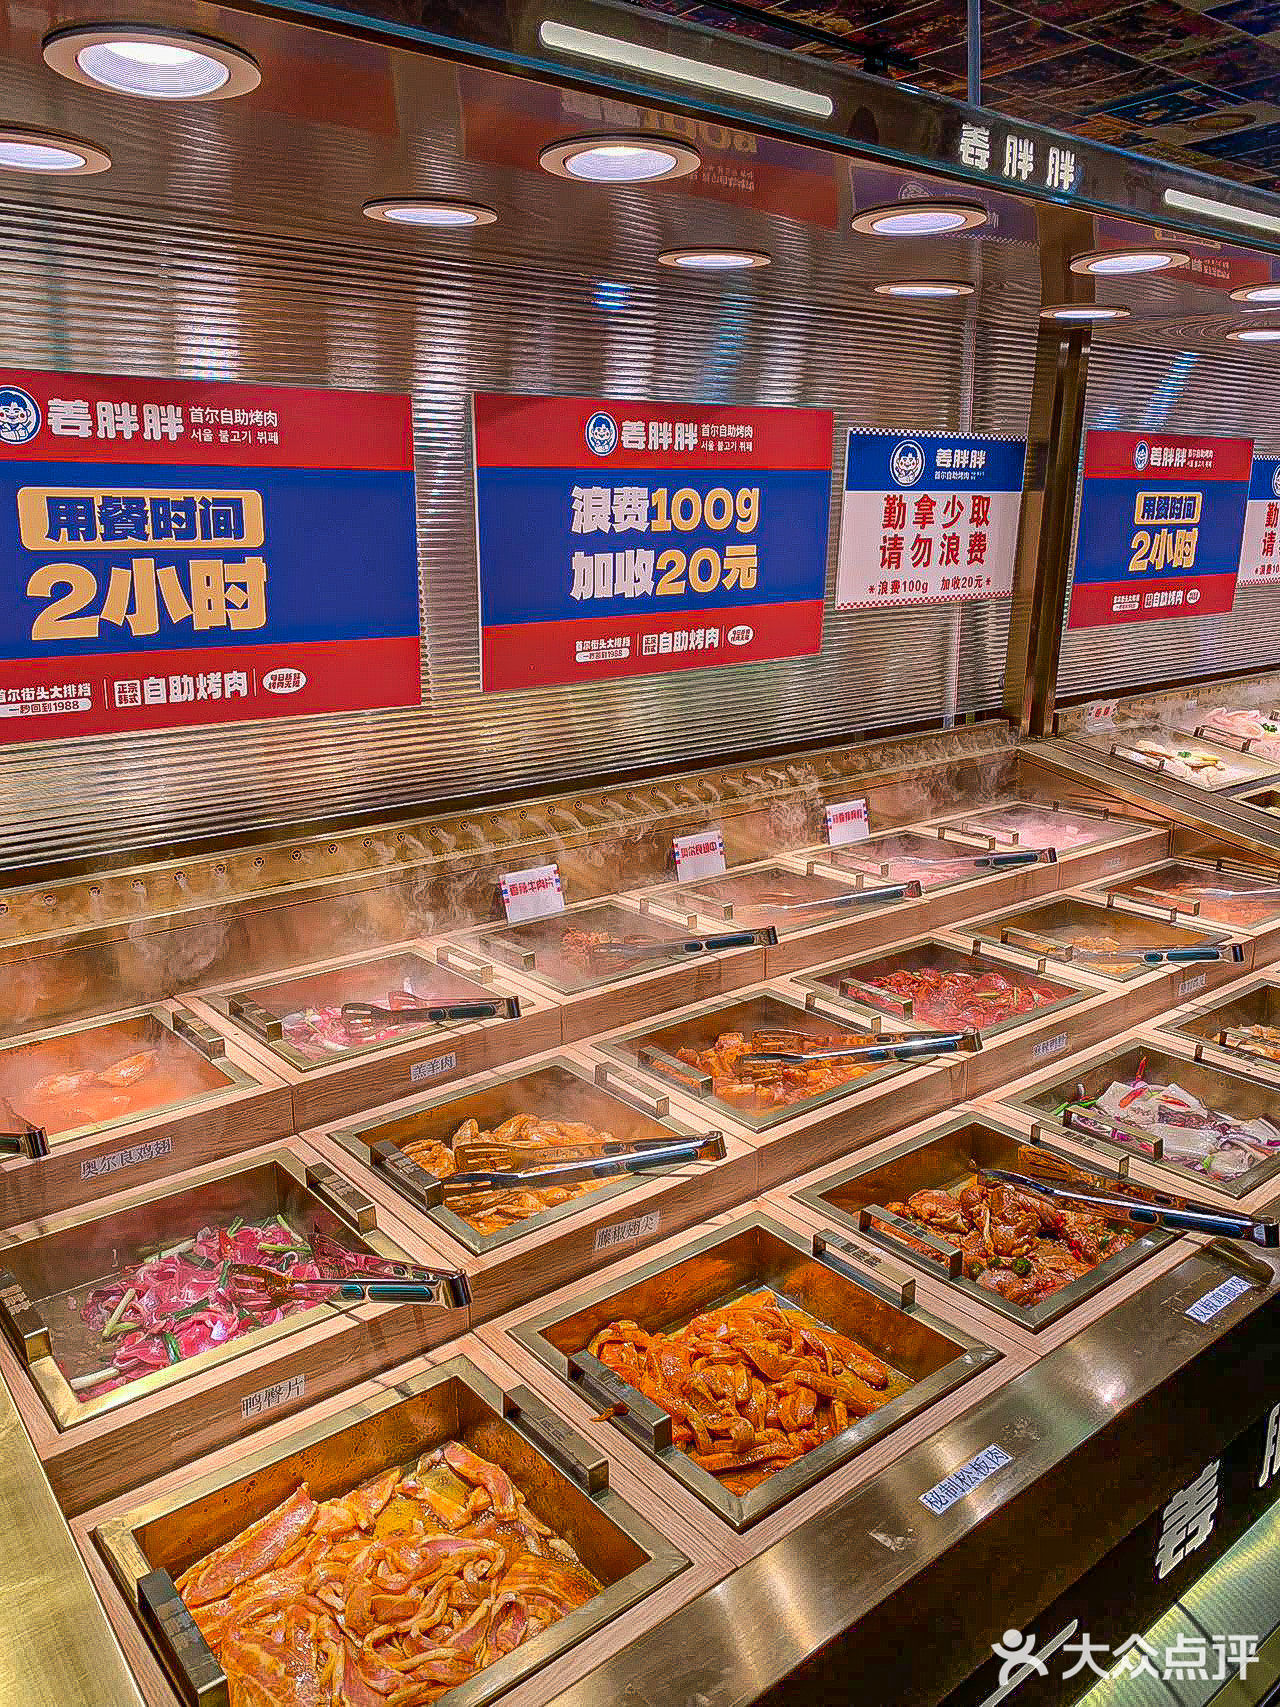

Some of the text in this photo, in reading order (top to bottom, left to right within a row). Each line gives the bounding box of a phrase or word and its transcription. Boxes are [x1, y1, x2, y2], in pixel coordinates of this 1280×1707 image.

[189, 406, 278, 428] 首尔自助烤肉
[701, 424, 753, 438] 首尔自助烤肉
[191, 428, 279, 445] 서울 불고기 뷔페
[45, 496, 245, 542] 用餐时间
[571, 486, 760, 534] 浪费100g
[882, 494, 991, 530] 勤拿少取
[1142, 496, 1197, 520] 用餐时间
[880, 531, 988, 570] 请勿浪费
[1128, 528, 1199, 572] 2小时
[570, 544, 757, 600] 加收20元
[878, 575, 983, 595] 浪费100g 加收20元
[27, 556, 266, 640] 2小时
[659, 627, 719, 653] 自助烤肉
[143, 670, 248, 704] 自助烤肉
[9, 700, 80, 714] 一秒回到1988
[81, 1138, 170, 1180] 奥尔良鸡翅
